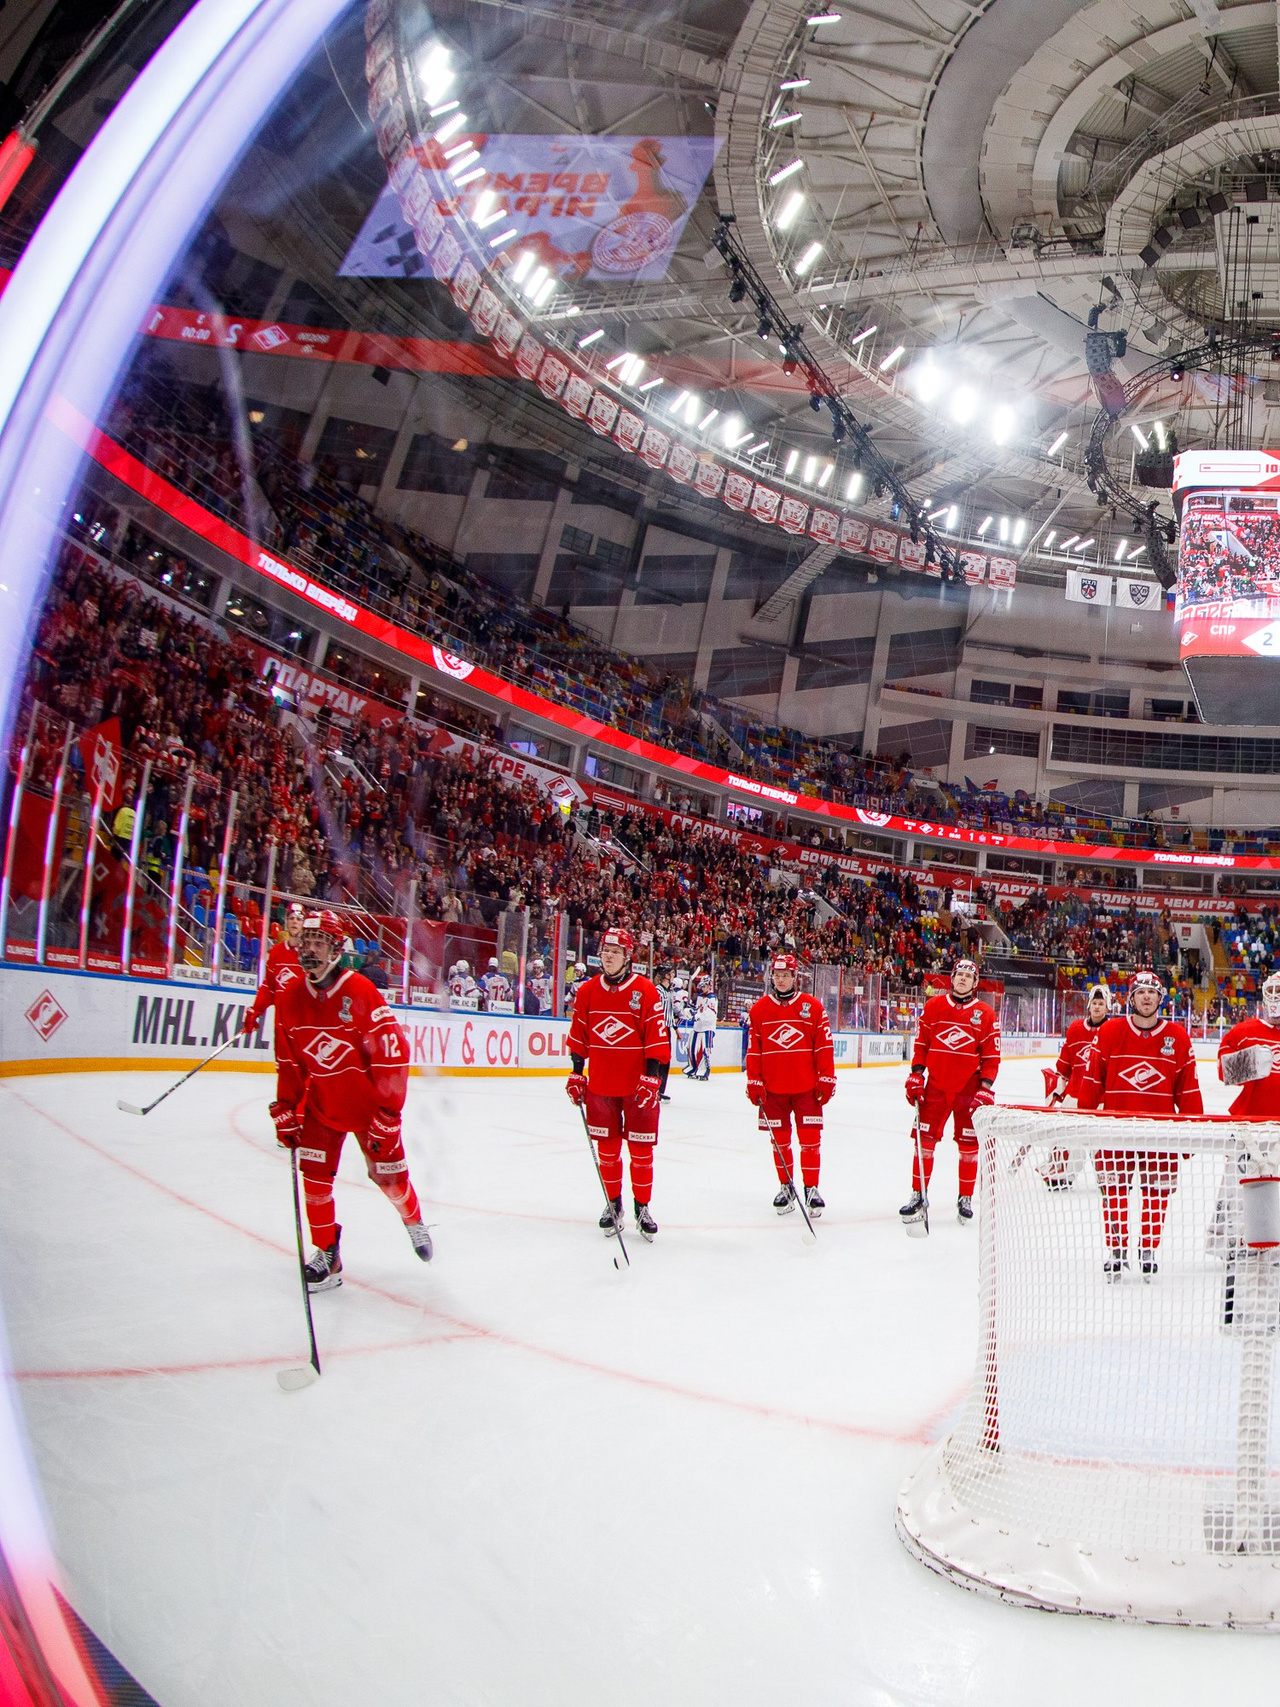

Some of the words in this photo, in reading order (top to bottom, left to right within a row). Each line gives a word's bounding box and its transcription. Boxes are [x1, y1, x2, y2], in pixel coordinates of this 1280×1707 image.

[257, 552, 307, 592] ТОЛЬКО
[1210, 625, 1236, 636] СПР
[1262, 632, 1273, 646] 2
[262, 656, 368, 714] СПАРТАК
[728, 775, 761, 794] ТОЛЬКО
[760, 785, 798, 805] ВПЕРЁД!
[938, 827, 944, 836] 2
[969, 832, 974, 841] 1
[1036, 827, 1060, 839] 46
[799, 850, 864, 874] БОЛЬШЕ,
[1153, 852, 1192, 864] ТОЛЬКО
[1193, 855, 1235, 867] ВПЕРЁД!
[980, 880, 1048, 896] СПАРТАК
[1090, 892, 1160, 909] БОЛЬШЕ,
[1163, 896, 1198, 909] ЧЕМ
[1199, 898, 1236, 910] ИГРА
[47, 952, 79, 965] OLIMPBET
[87, 957, 121, 971] OLIMPBET
[131, 963, 166, 976] OLIMPBET
[381, 1032, 402, 1058] 12
[462, 1021, 475, 1065] &
[486, 1029, 519, 1066] CO.
[629, 1133, 654, 1142] МОСКВА
